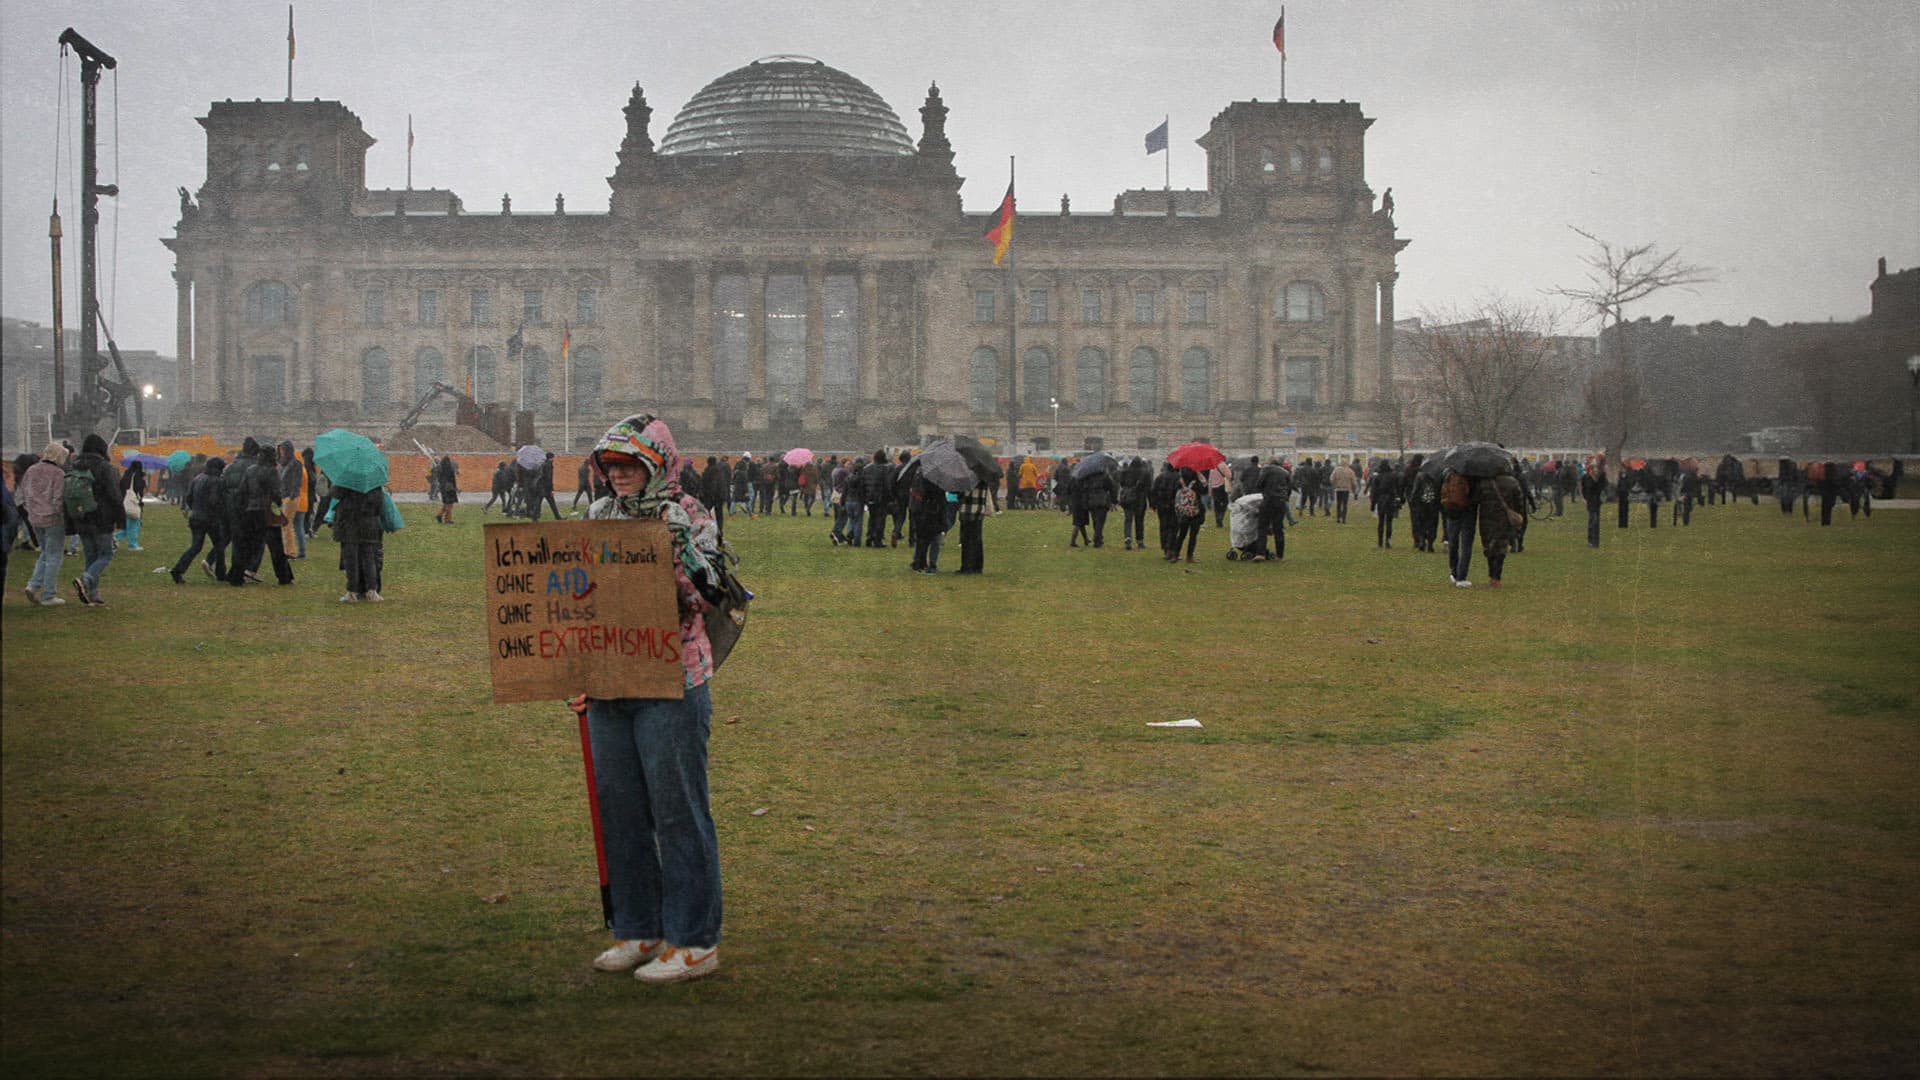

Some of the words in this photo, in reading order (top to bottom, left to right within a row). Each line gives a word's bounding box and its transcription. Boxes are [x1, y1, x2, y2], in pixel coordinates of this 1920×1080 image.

[496, 537, 523, 566] Ich
[528, 537, 550, 564] will
[496, 573, 535, 594] OHNE
[546, 567, 589, 595] AfD
[498, 603, 532, 624] OHNE
[547, 601, 596, 623] Hass
[499, 635, 535, 659] OHNE
[539, 625, 680, 664] EXTREMISMUS
